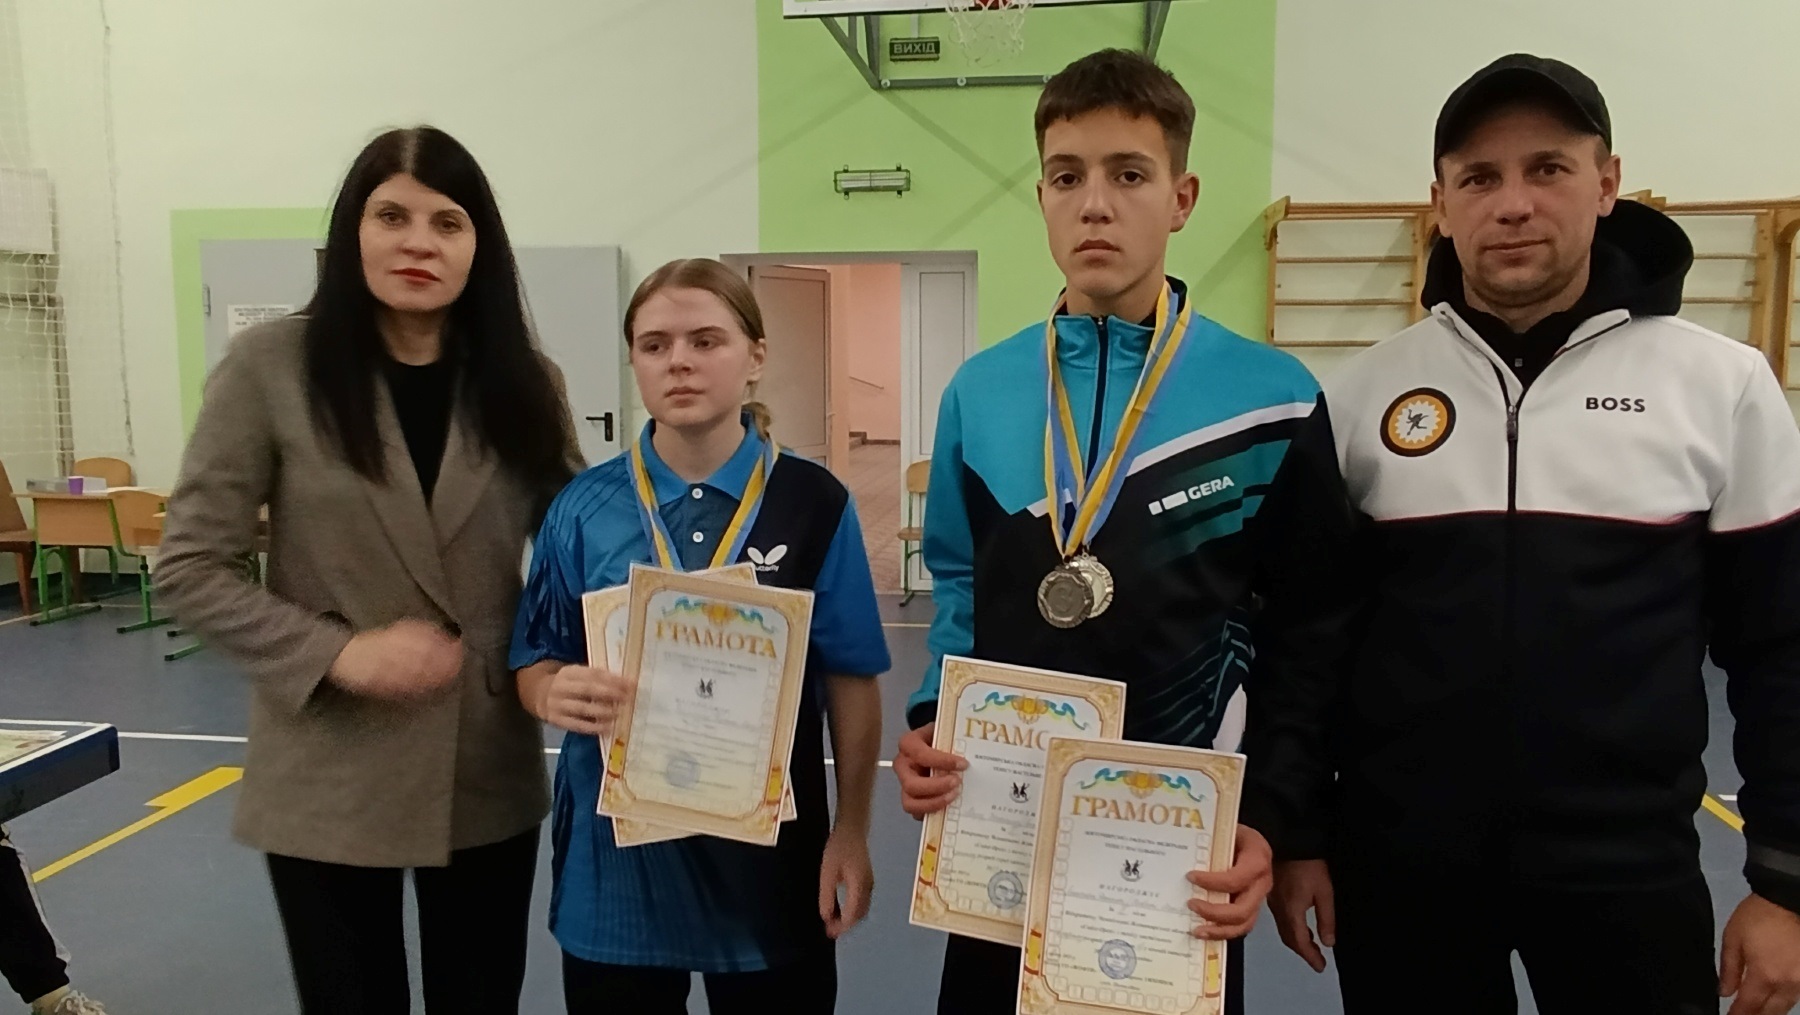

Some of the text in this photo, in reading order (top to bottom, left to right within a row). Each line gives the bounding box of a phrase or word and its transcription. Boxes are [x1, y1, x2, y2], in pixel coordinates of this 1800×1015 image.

[893, 42, 936, 54] ВИХІД
[1586, 397, 1645, 413] BOSS
[1187, 475, 1235, 500] GERA
[754, 564, 780, 573] utterfly
[655, 620, 777, 659] ГРАМОТА
[964, 717, 1049, 751] ГРАМО
[1070, 795, 1205, 830] ГРАМОТА
